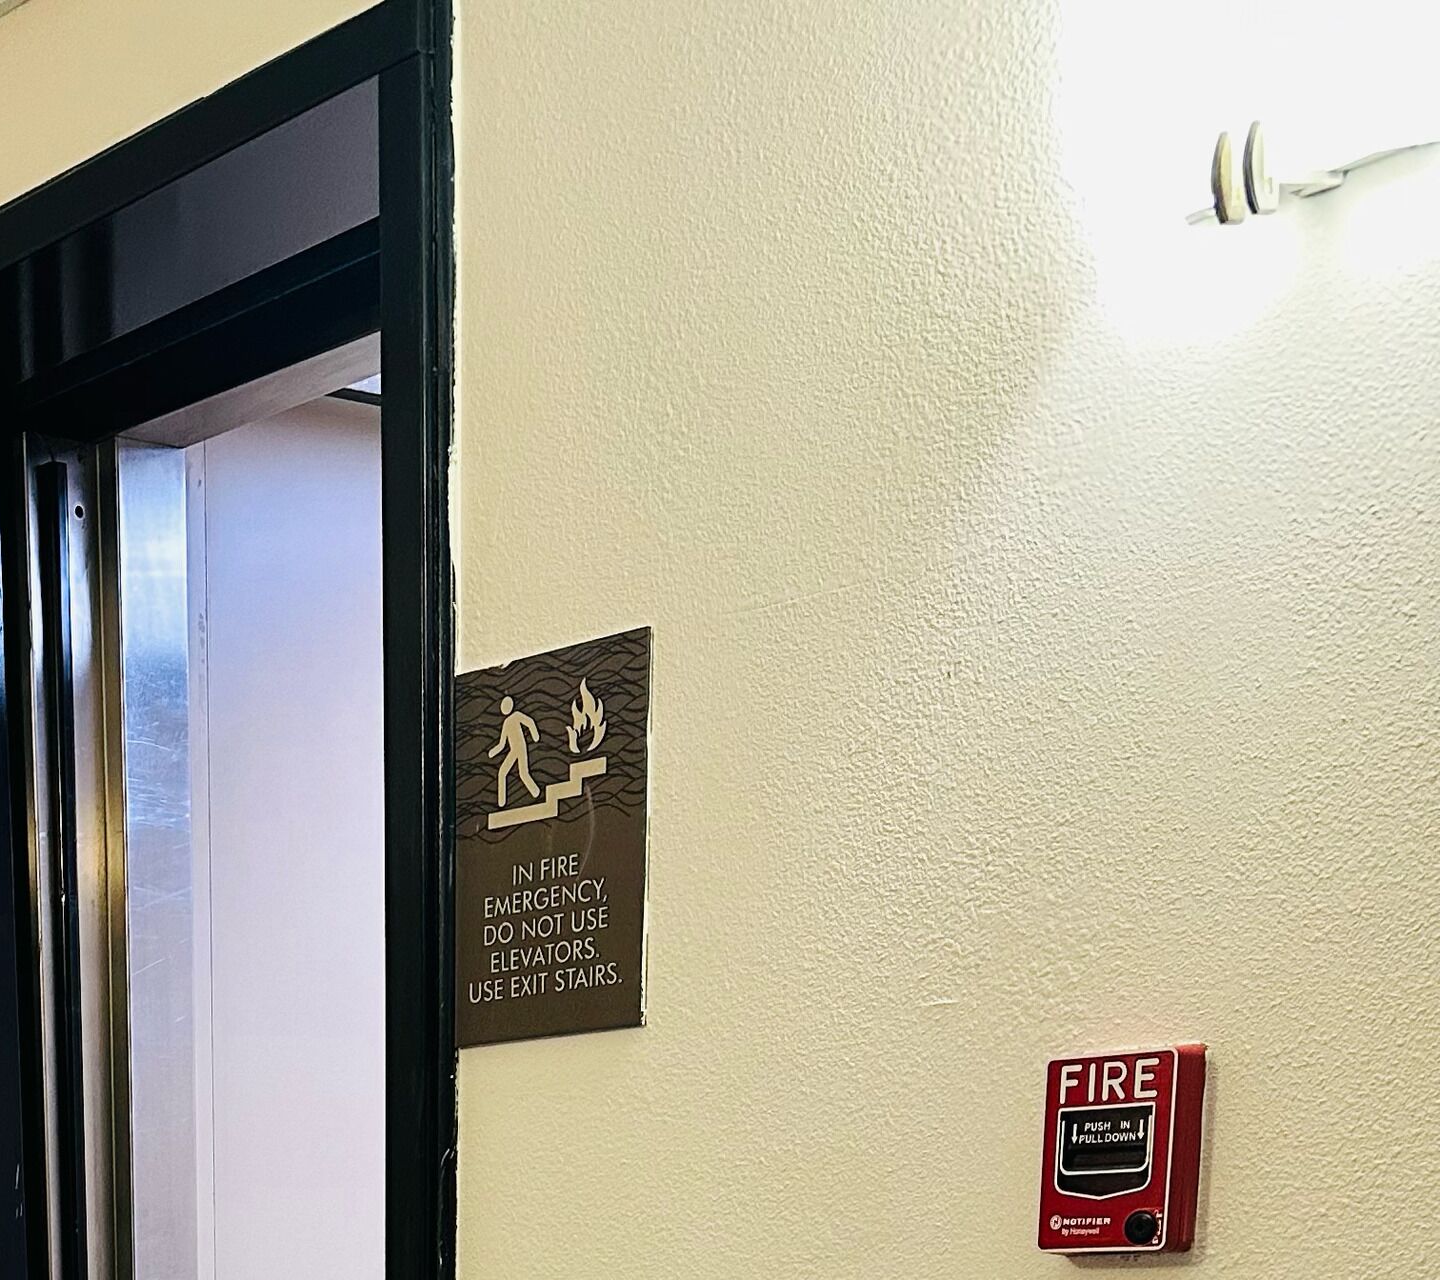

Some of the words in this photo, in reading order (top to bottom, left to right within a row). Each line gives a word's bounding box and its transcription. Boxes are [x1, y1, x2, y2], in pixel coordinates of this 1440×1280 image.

[513, 862, 533, 886] IN
[540, 853, 579, 881] FIRE
[484, 877, 608, 918] EMERGENCY,
[484, 921, 514, 946] DO
[521, 913, 565, 940] NOT
[571, 906, 609, 933] USE
[490, 936, 600, 973] ELEVATORS.
[469, 978, 504, 1004] USE
[511, 972, 549, 998] EXIT
[554, 962, 623, 992] STAIRS.
[1059, 1057, 1160, 1105] FIRE
[1079, 1133, 1103, 1144] PULL
[1104, 1131, 1137, 1143] DOWN
[1084, 1121, 1111, 1132] PUSH
[1120, 1120, 1131, 1130] IN
[1063, 1217, 1111, 1226] NOTIFIER
